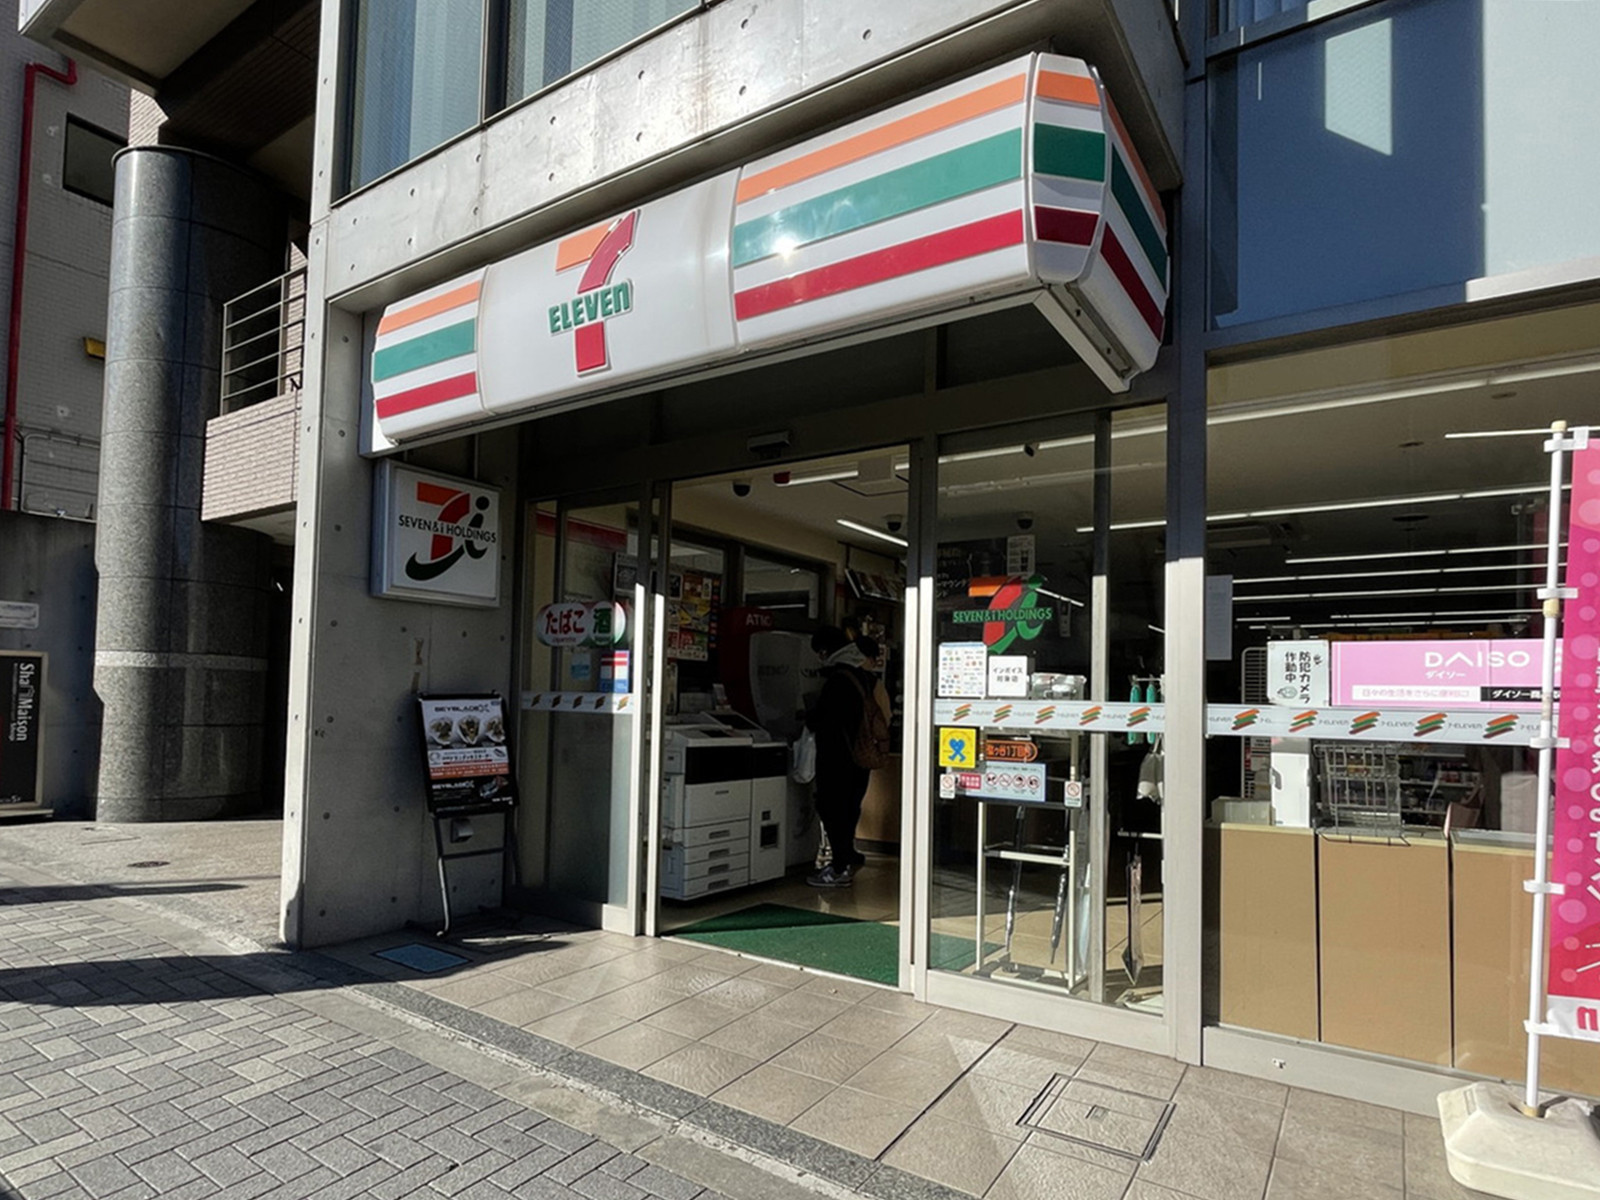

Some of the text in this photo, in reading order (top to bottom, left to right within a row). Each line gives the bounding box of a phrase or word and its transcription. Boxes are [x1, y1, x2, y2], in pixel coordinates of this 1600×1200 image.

[446, 525, 497, 543] HOLDINGS
[545, 608, 585, 634] たばこ
[592, 607, 613, 634] 酒
[997, 607, 1053, 621] HOLDINGS
[1285, 651, 1297, 683] 作動中
[1425, 650, 1530, 668] DAISO
[1299, 651, 1312, 704] 防犯カメラ
[1425, 670, 1466, 680] ダイソー
[16, 698, 33, 742] Maison
